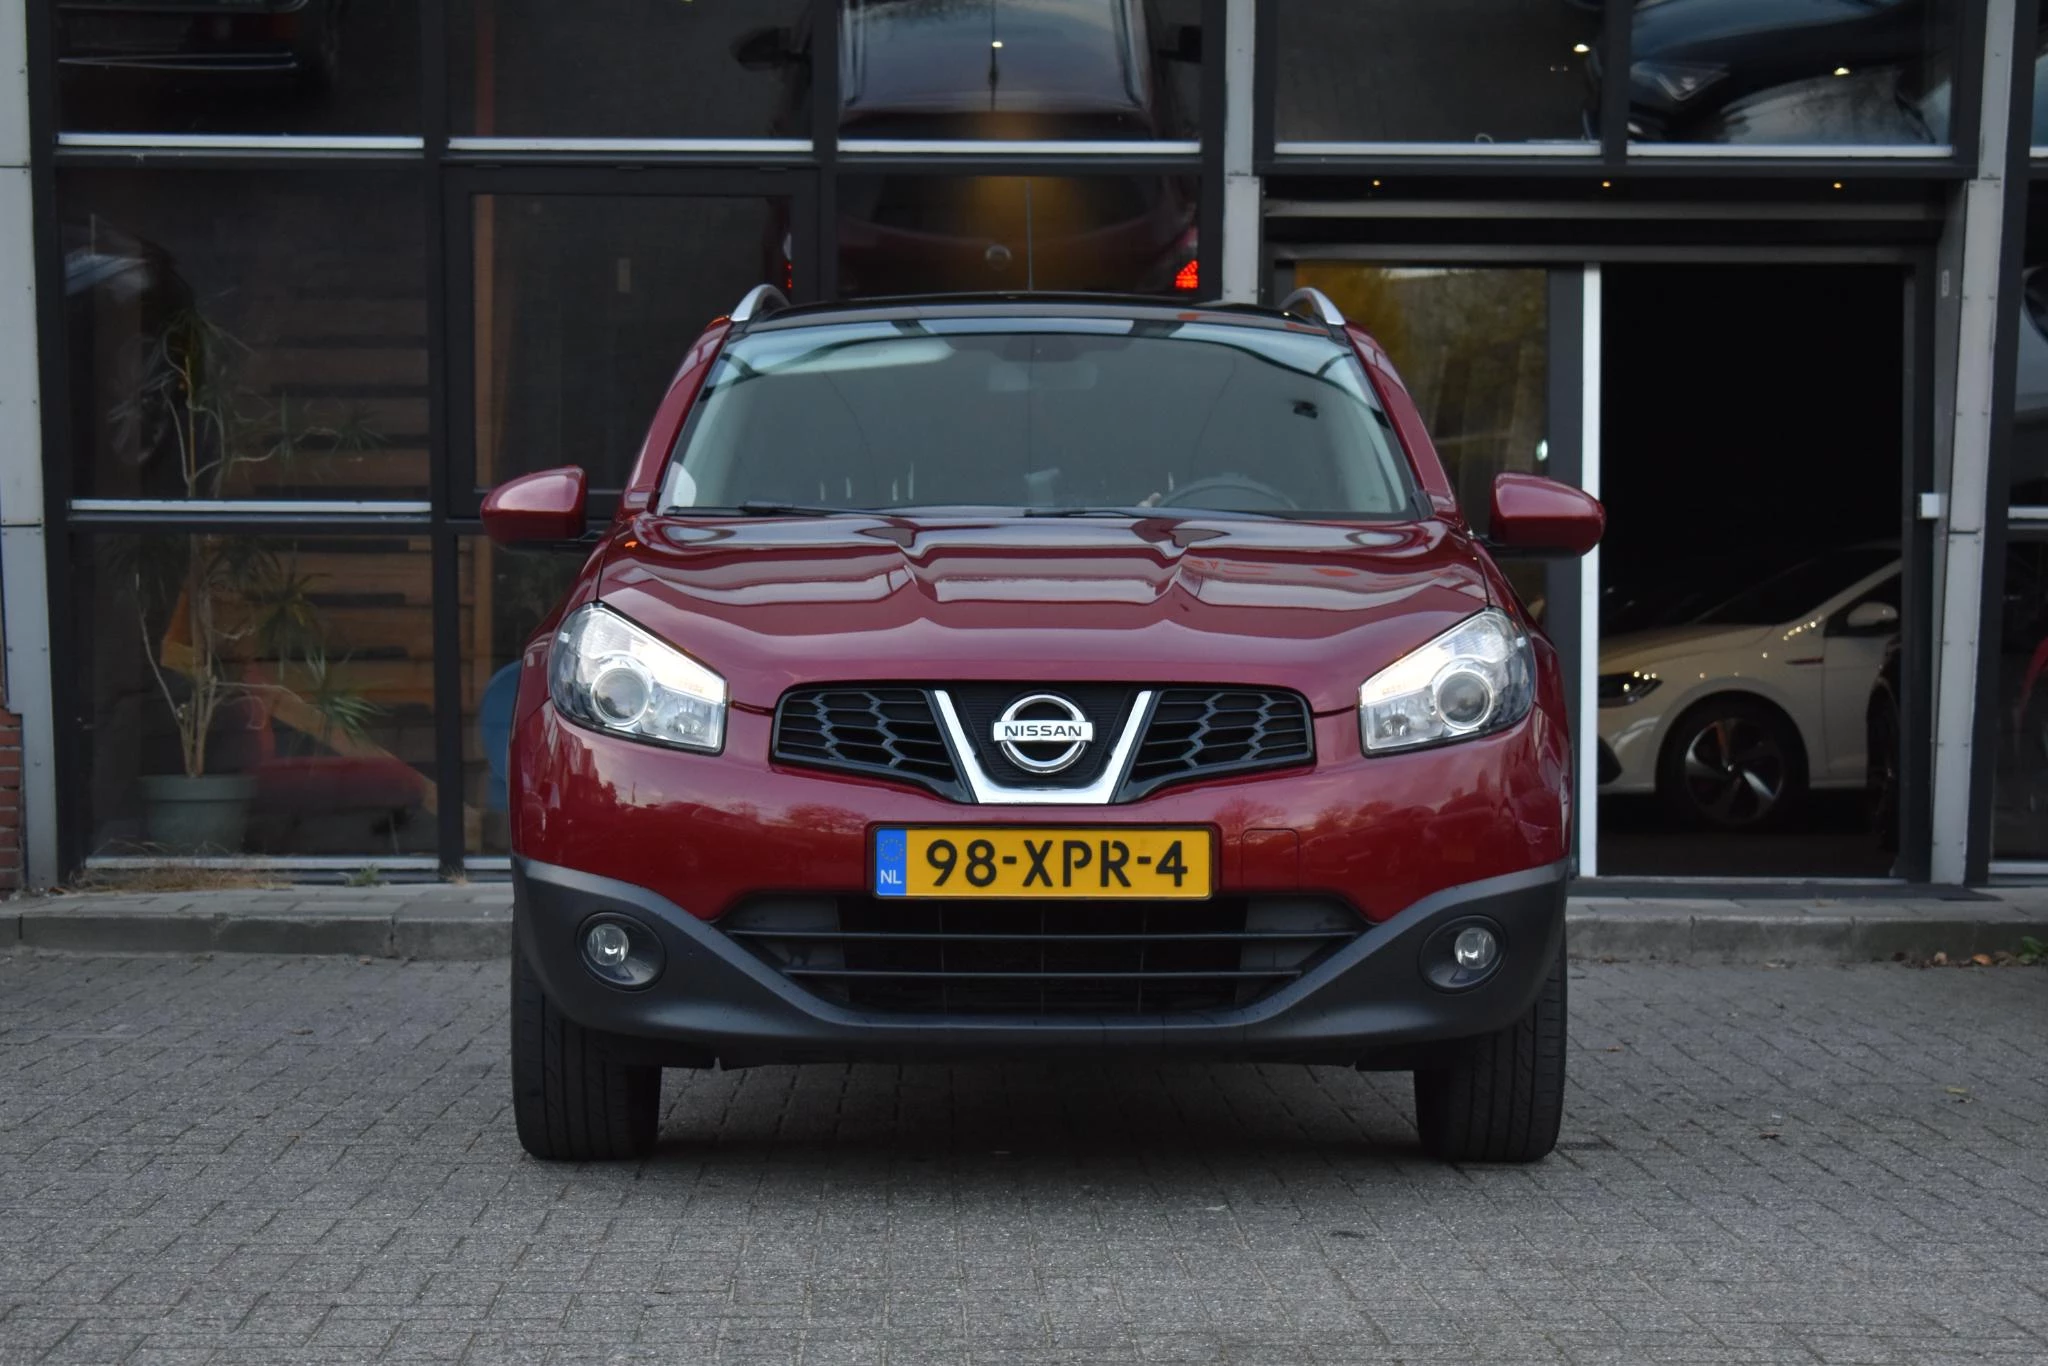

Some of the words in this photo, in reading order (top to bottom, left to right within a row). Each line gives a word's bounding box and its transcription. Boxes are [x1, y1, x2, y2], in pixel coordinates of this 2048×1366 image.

[1004, 725, 1082, 737] NISSAN
[926, 839, 1188, 888] 98-XPR-4
[880, 869, 902, 884] NL
